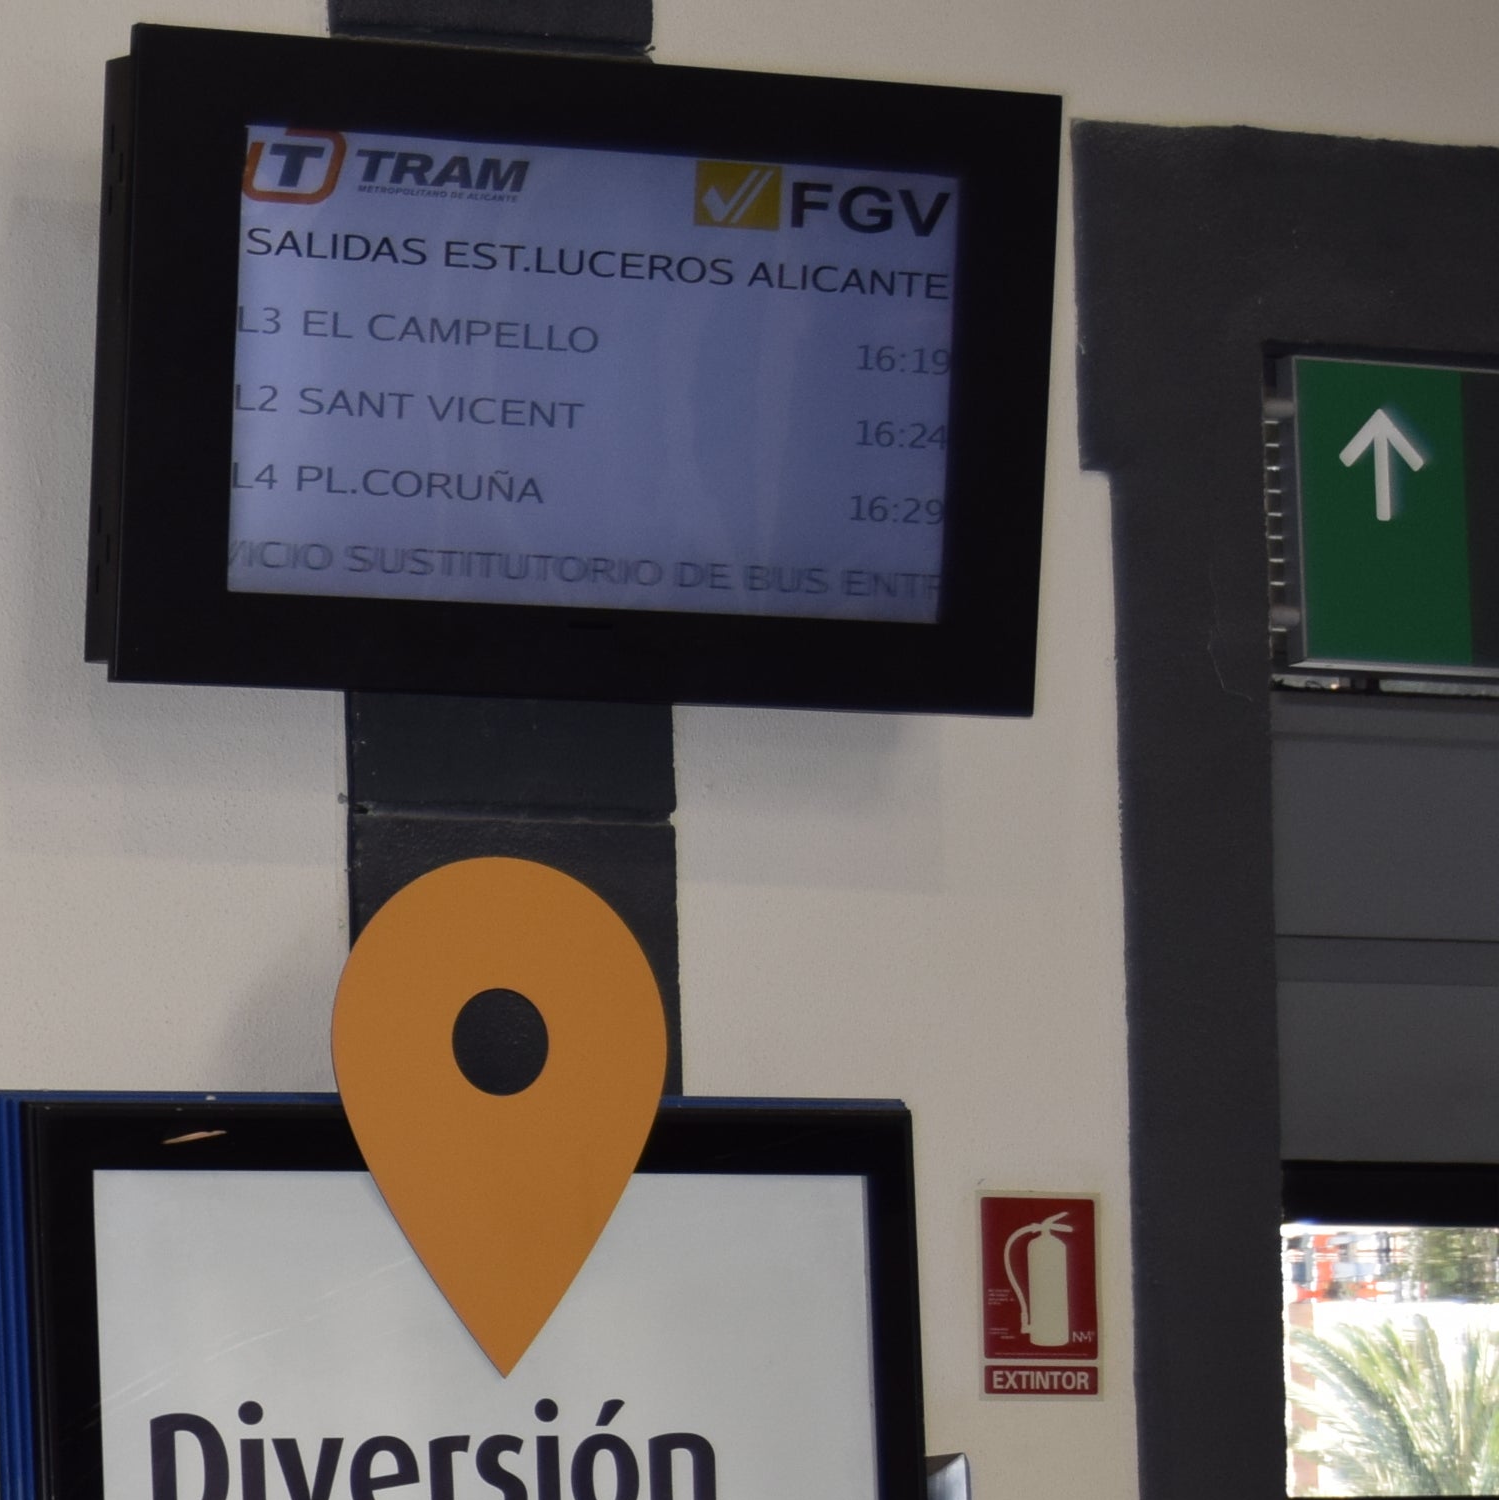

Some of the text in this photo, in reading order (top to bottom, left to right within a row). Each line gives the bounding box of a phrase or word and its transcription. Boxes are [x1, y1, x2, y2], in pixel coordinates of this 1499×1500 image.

[356, 148, 530, 193] TRAM
[357, 184, 518, 204] METROPOLITANO DE ALICANTE
[791, 182, 951, 238] FGV
[246, 227, 949, 300] SALIDAS EST.LUCEROS ALICANTE
[237, 306, 951, 376] L3 EL CAMPELLO 16:19
[235, 384, 947, 450] L2 SANT VICENT 16:24
[231, 462, 945, 526] L4 PL.CORUÑA 16:29
[345, 545, 663, 587] SUSTITUTORIO
[675, 562, 733, 590] DE
[743, 565, 829, 595] BUS
[992, 1371, 1089, 1390] EXTINTOR
